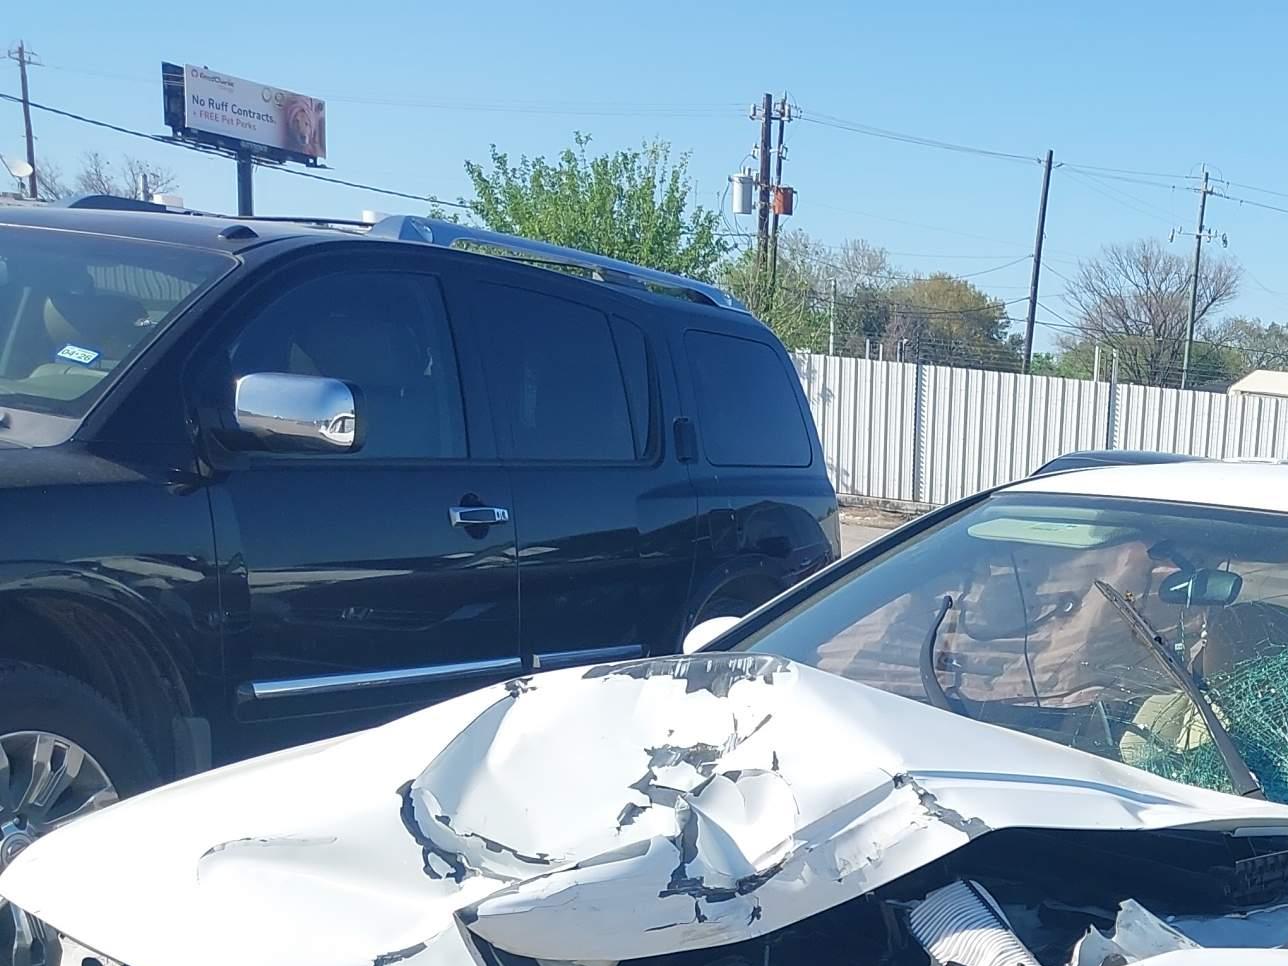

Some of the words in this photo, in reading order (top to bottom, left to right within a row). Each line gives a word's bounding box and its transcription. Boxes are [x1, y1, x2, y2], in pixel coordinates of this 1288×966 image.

[192, 95, 206, 107] No
[209, 98, 228, 113] Ruff
[200, 111, 219, 122] FREE
[221, 114, 234, 126] Pet
